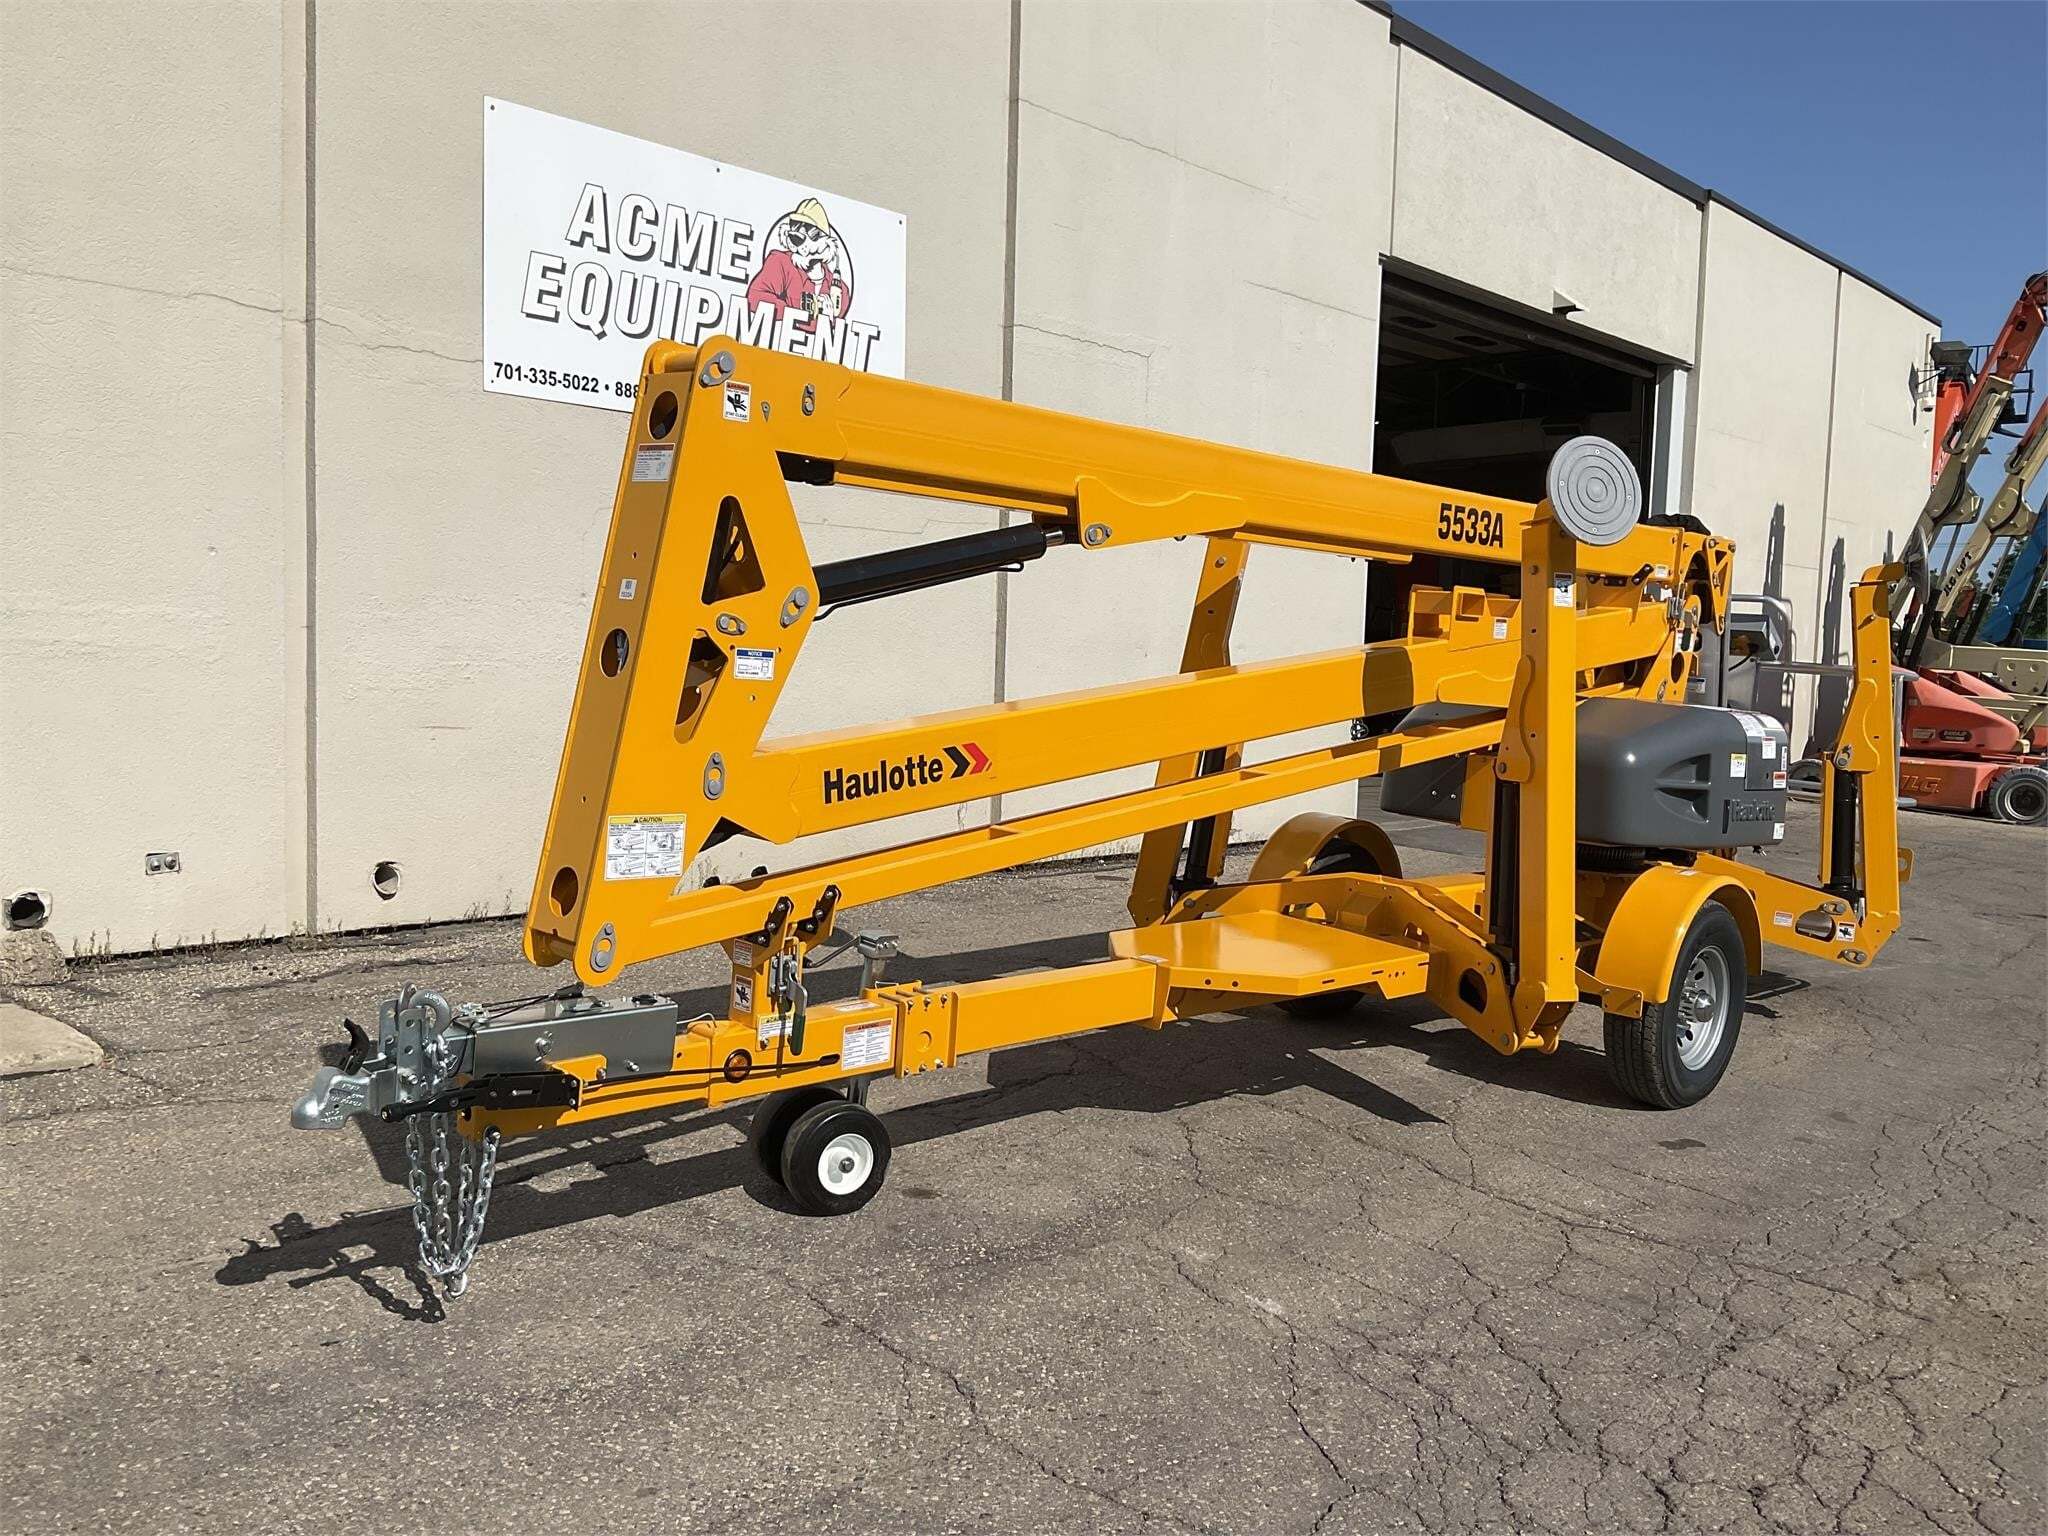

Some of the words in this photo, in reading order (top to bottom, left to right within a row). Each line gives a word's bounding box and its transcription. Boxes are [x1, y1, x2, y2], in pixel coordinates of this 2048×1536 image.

[565, 182, 754, 284] ACME
[520, 250, 881, 373] EQUIPMENT
[494, 362, 600, 393] 701-335-5022
[1438, 502, 1503, 549] 5533A
[824, 755, 943, 805] Haulotte
